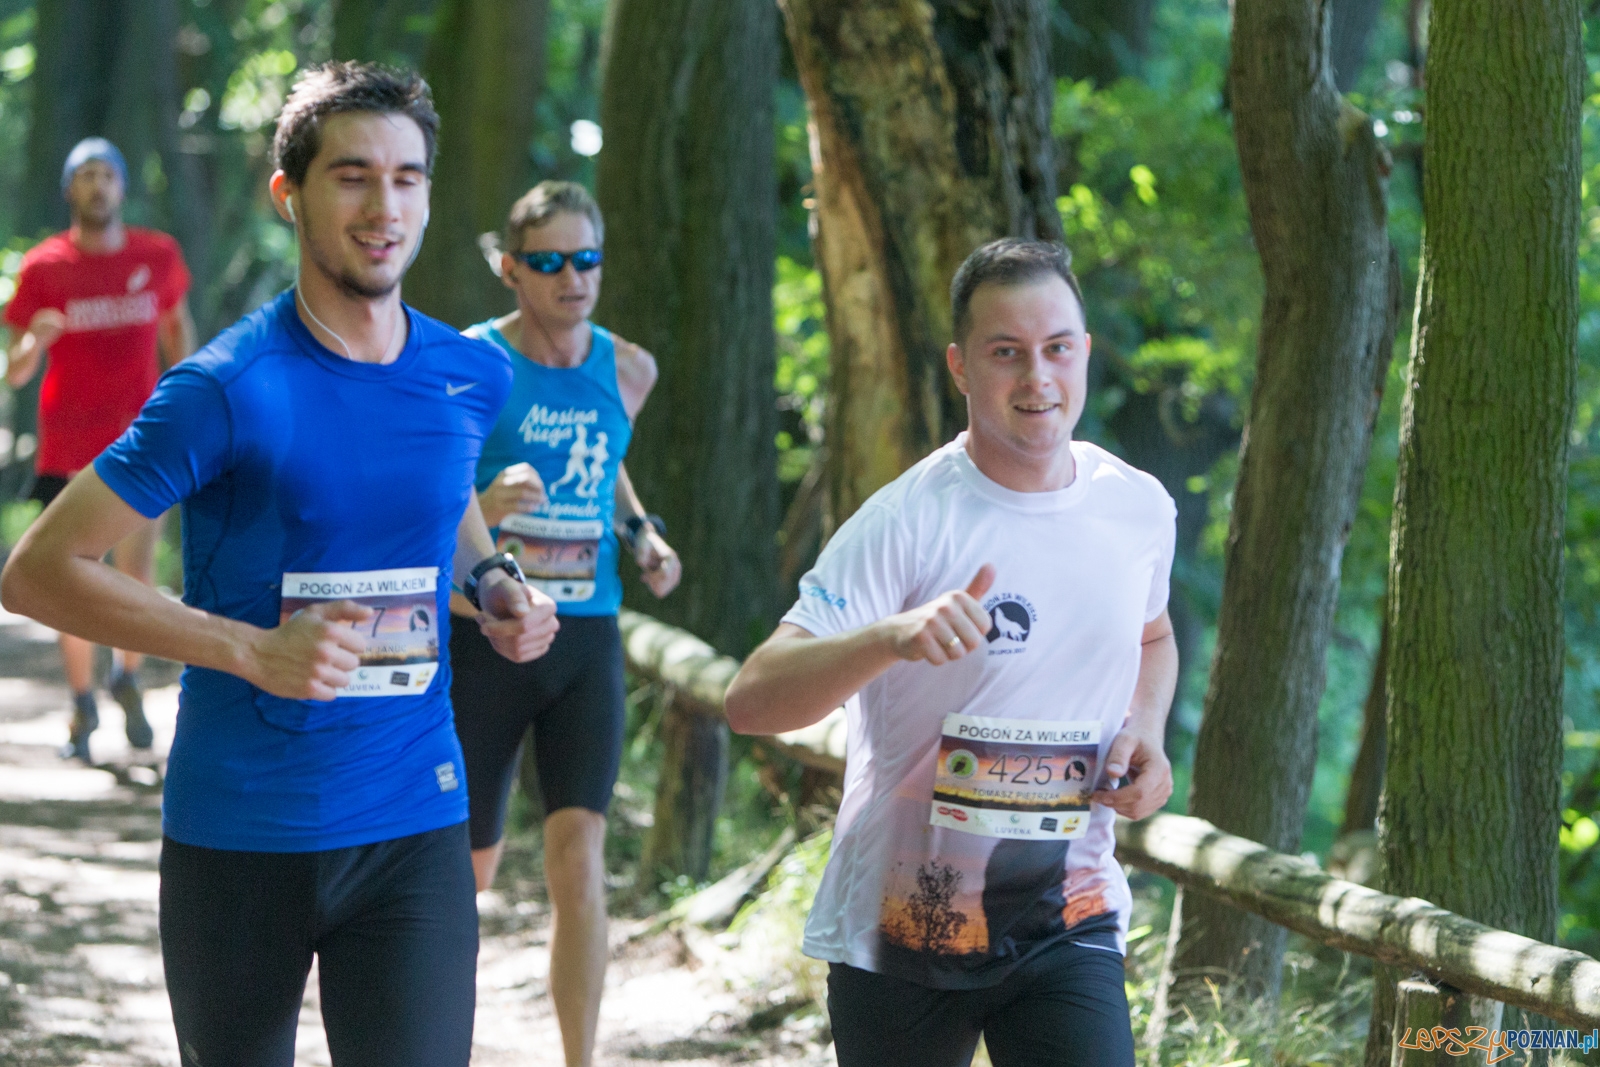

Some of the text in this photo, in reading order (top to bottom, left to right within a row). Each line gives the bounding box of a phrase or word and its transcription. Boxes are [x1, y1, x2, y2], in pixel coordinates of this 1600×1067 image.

[299, 577, 426, 595] POGOŃ ZA WILKIEM
[958, 724, 1090, 742] POGOŃ ZA WILKIEM
[987, 754, 1053, 785] 425
[973, 787, 1013, 799] TOMASZ
[995, 827, 1032, 835] LUVENA
